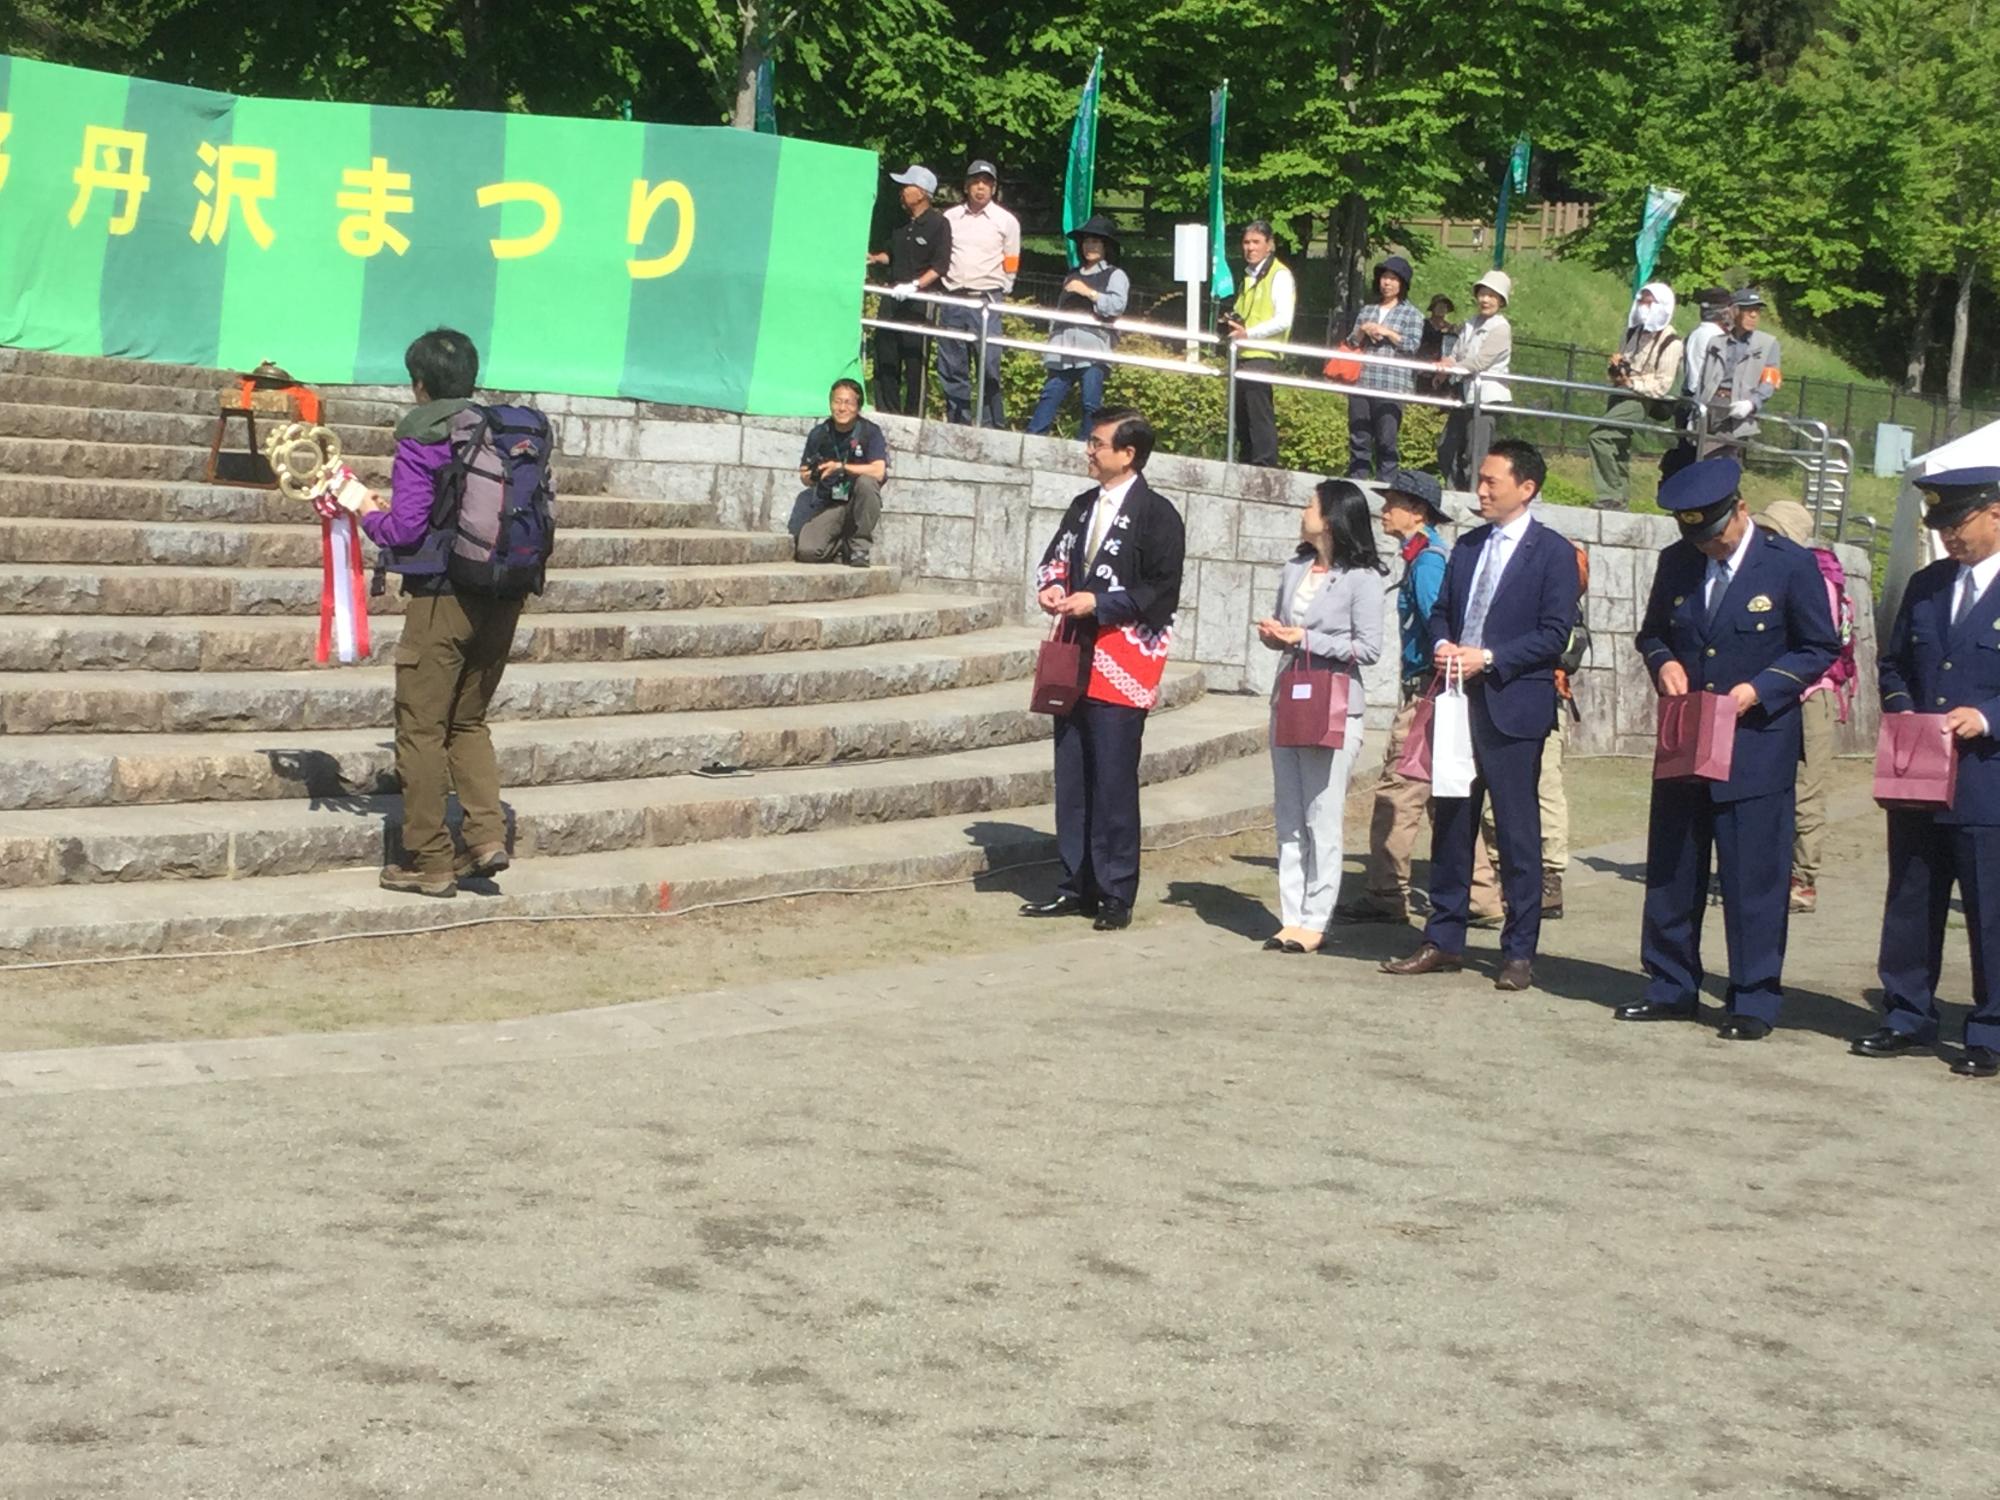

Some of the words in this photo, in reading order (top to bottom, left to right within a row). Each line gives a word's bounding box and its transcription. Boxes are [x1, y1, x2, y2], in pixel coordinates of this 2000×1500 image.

[0, 112, 696, 280] 丹沢まつり
